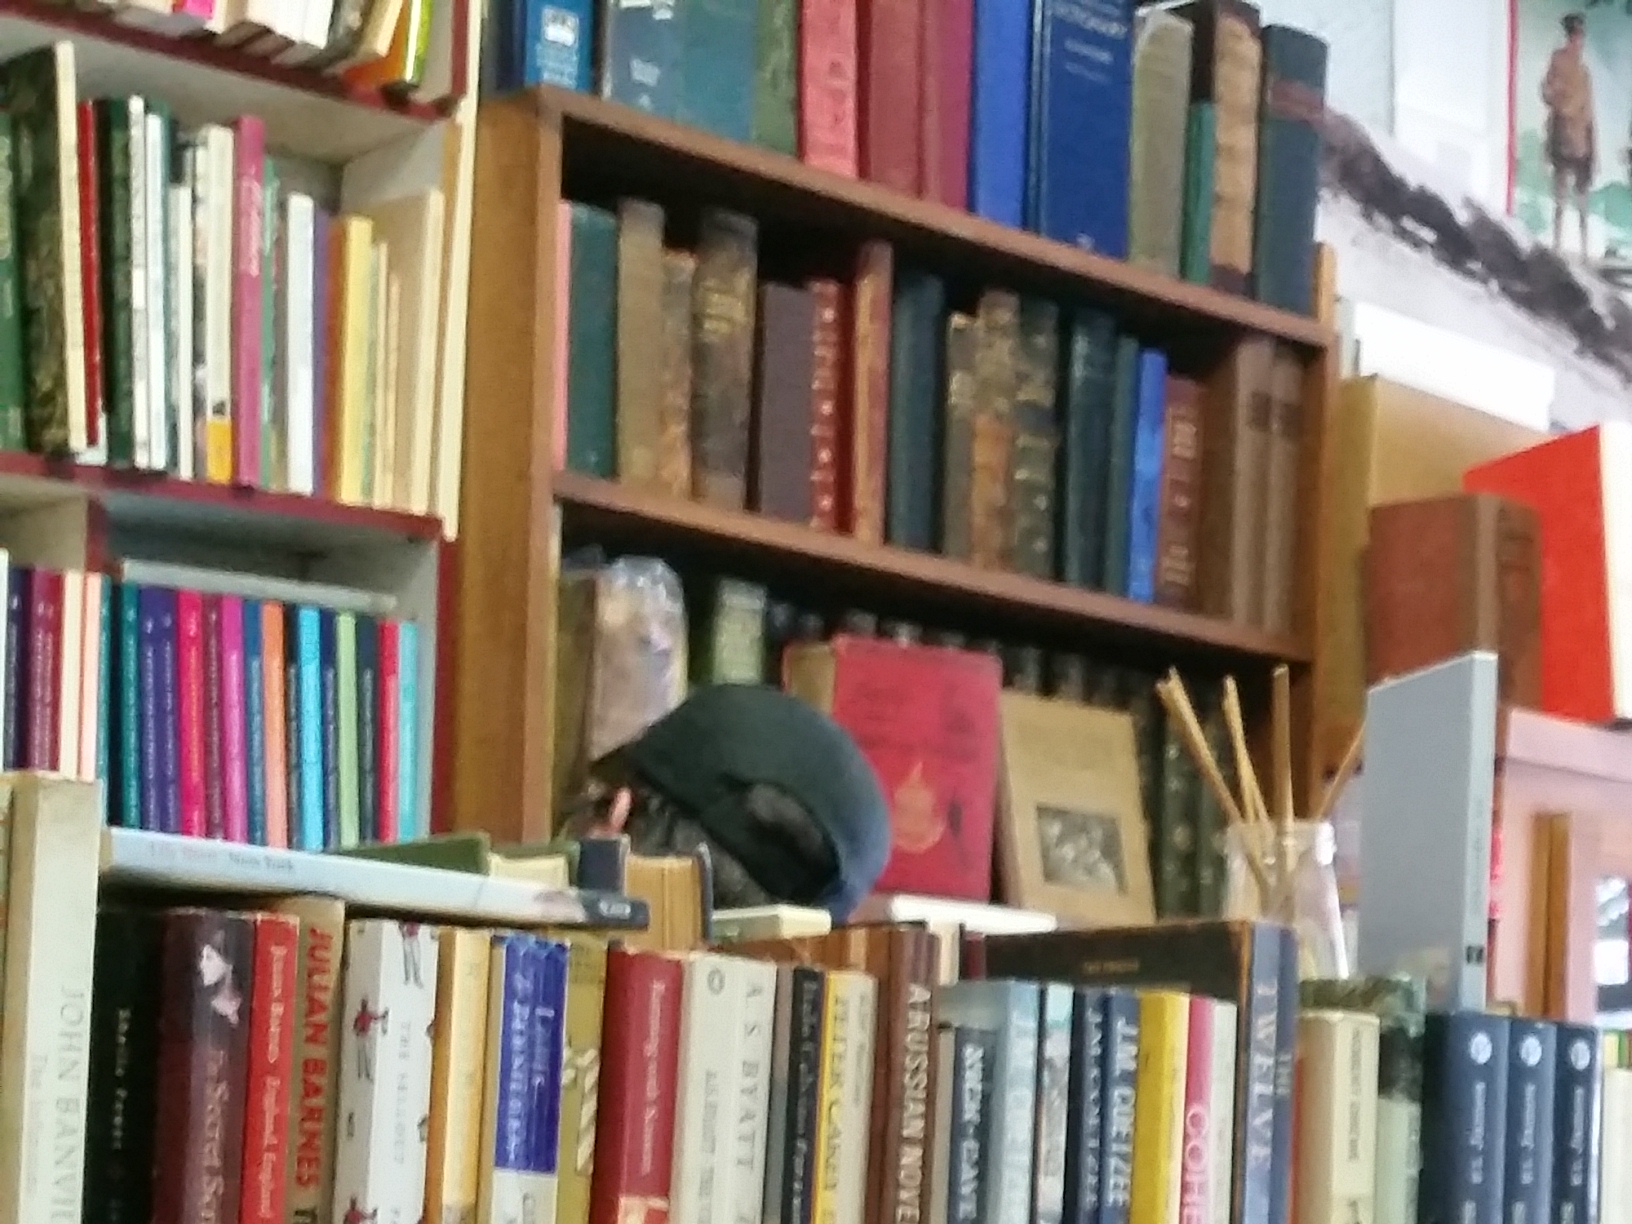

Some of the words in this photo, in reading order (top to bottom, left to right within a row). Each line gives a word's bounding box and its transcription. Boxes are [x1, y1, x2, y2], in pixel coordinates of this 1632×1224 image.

[58, 985, 86, 1081] JOHN
[305, 926, 335, 1045] JULIAN
[907, 983, 931, 1004] A
[901, 1009, 932, 1139] RUSSIAN
[961, 1043, 985, 1126] NICK
[1114, 1016, 1139, 1077] J.M.
[1247, 981, 1279, 1174] TWELVE
[1274, 1052, 1292, 1098] THE
[203, 1080, 230, 1168] Secret
[295, 1058, 328, 1188] BARNES
[736, 1060, 760, 1170] BYATT
[1105, 1085, 1137, 1207] COETZEE
[958, 1137, 981, 1221] CAVE
